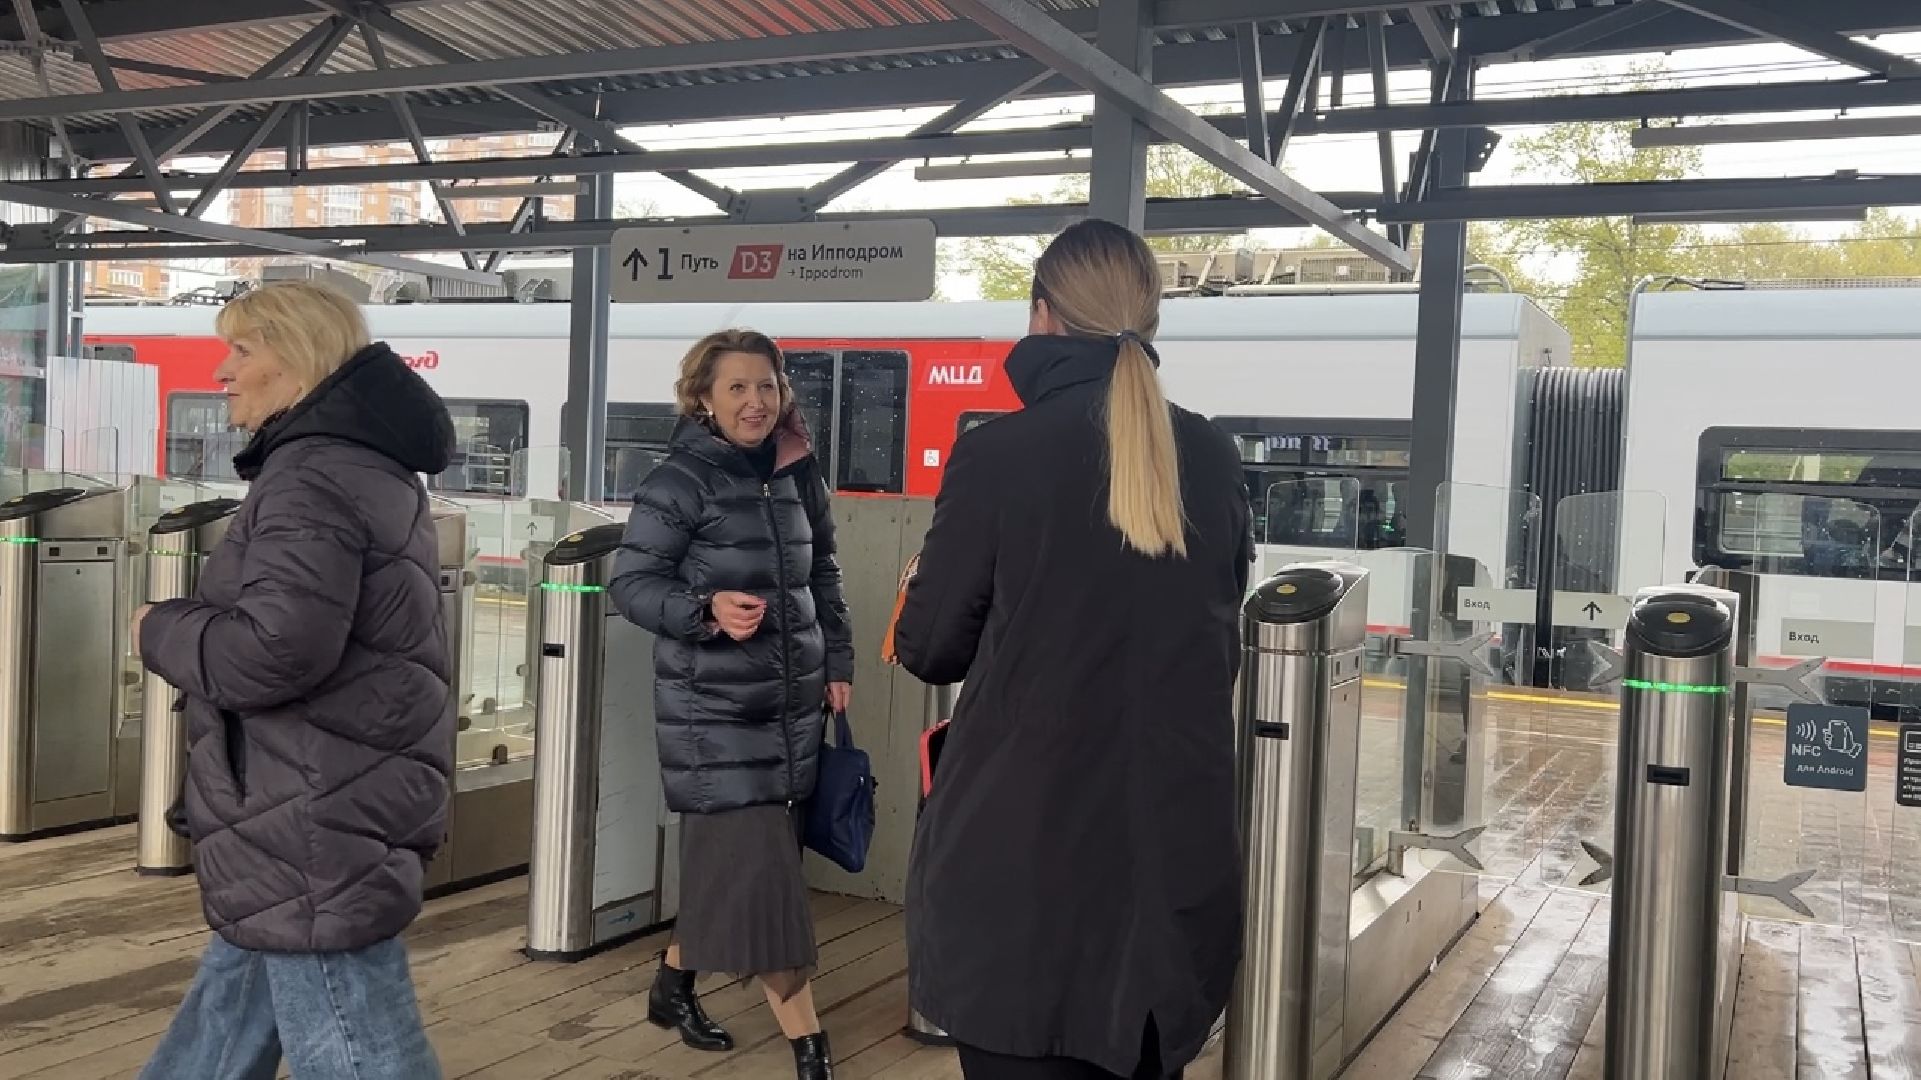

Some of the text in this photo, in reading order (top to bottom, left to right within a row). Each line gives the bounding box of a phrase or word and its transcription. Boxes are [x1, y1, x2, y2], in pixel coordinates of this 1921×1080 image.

[657, 244, 903, 280] 1 Путь D3 на Ипподром
[799, 266, 864, 281] Ippodrom
[928, 365, 984, 385] МЦД
[1463, 598, 1491, 611] Вход
[1788, 631, 1820, 644] Вход
[1791, 743, 1821, 757] NFC
[1816, 764, 1854, 777] Android
